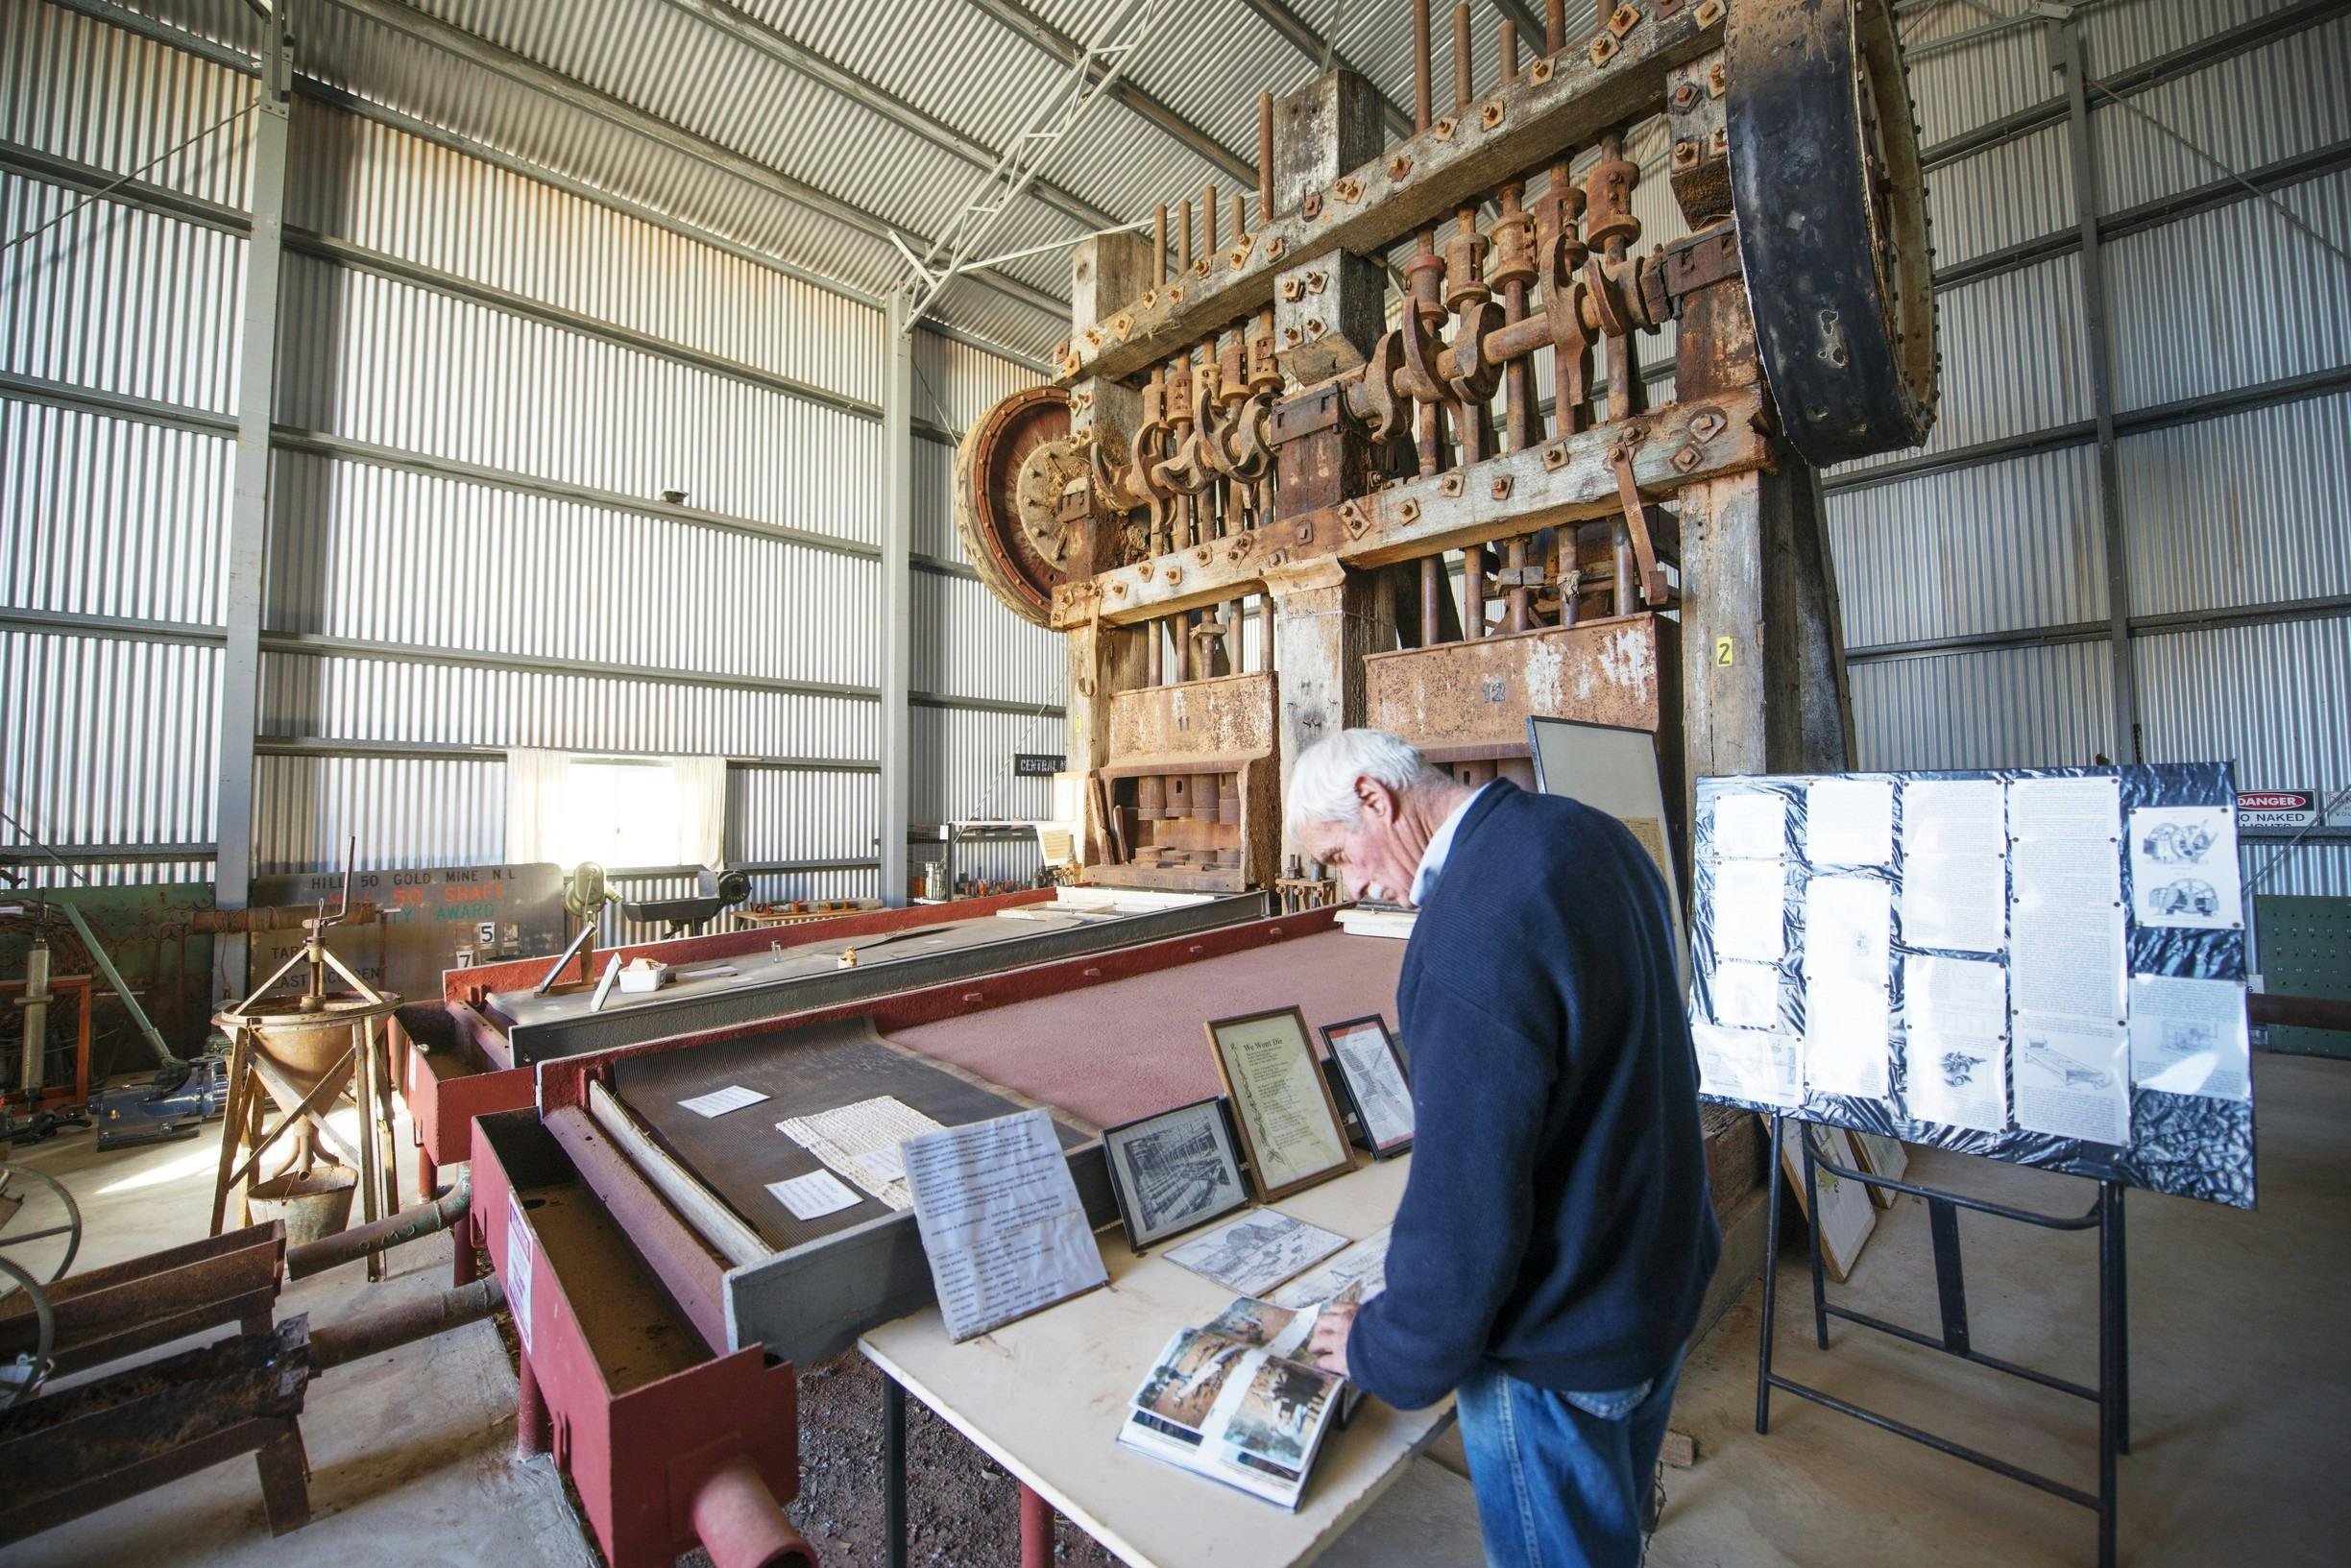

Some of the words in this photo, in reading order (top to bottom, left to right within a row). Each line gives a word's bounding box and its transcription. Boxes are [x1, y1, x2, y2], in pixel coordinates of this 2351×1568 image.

[1718, 642, 1731, 665] 2
[1020, 759, 1056, 772] CENTRAL
[2238, 797, 2297, 807] DANGER
[2256, 813, 2306, 822] NAKED
[311, 876, 345, 890] HILL
[360, 874, 379, 888] 50
[393, 873, 431, 885] GOLD
[446, 870, 478, 882] MINE
[392, 886, 424, 905] 50
[445, 883, 505, 903] SHAFT
[436, 904, 495, 921] AWARD
[481, 926, 493, 943] 5
[459, 954, 471, 968] 7
[271, 974, 308, 990] AST
